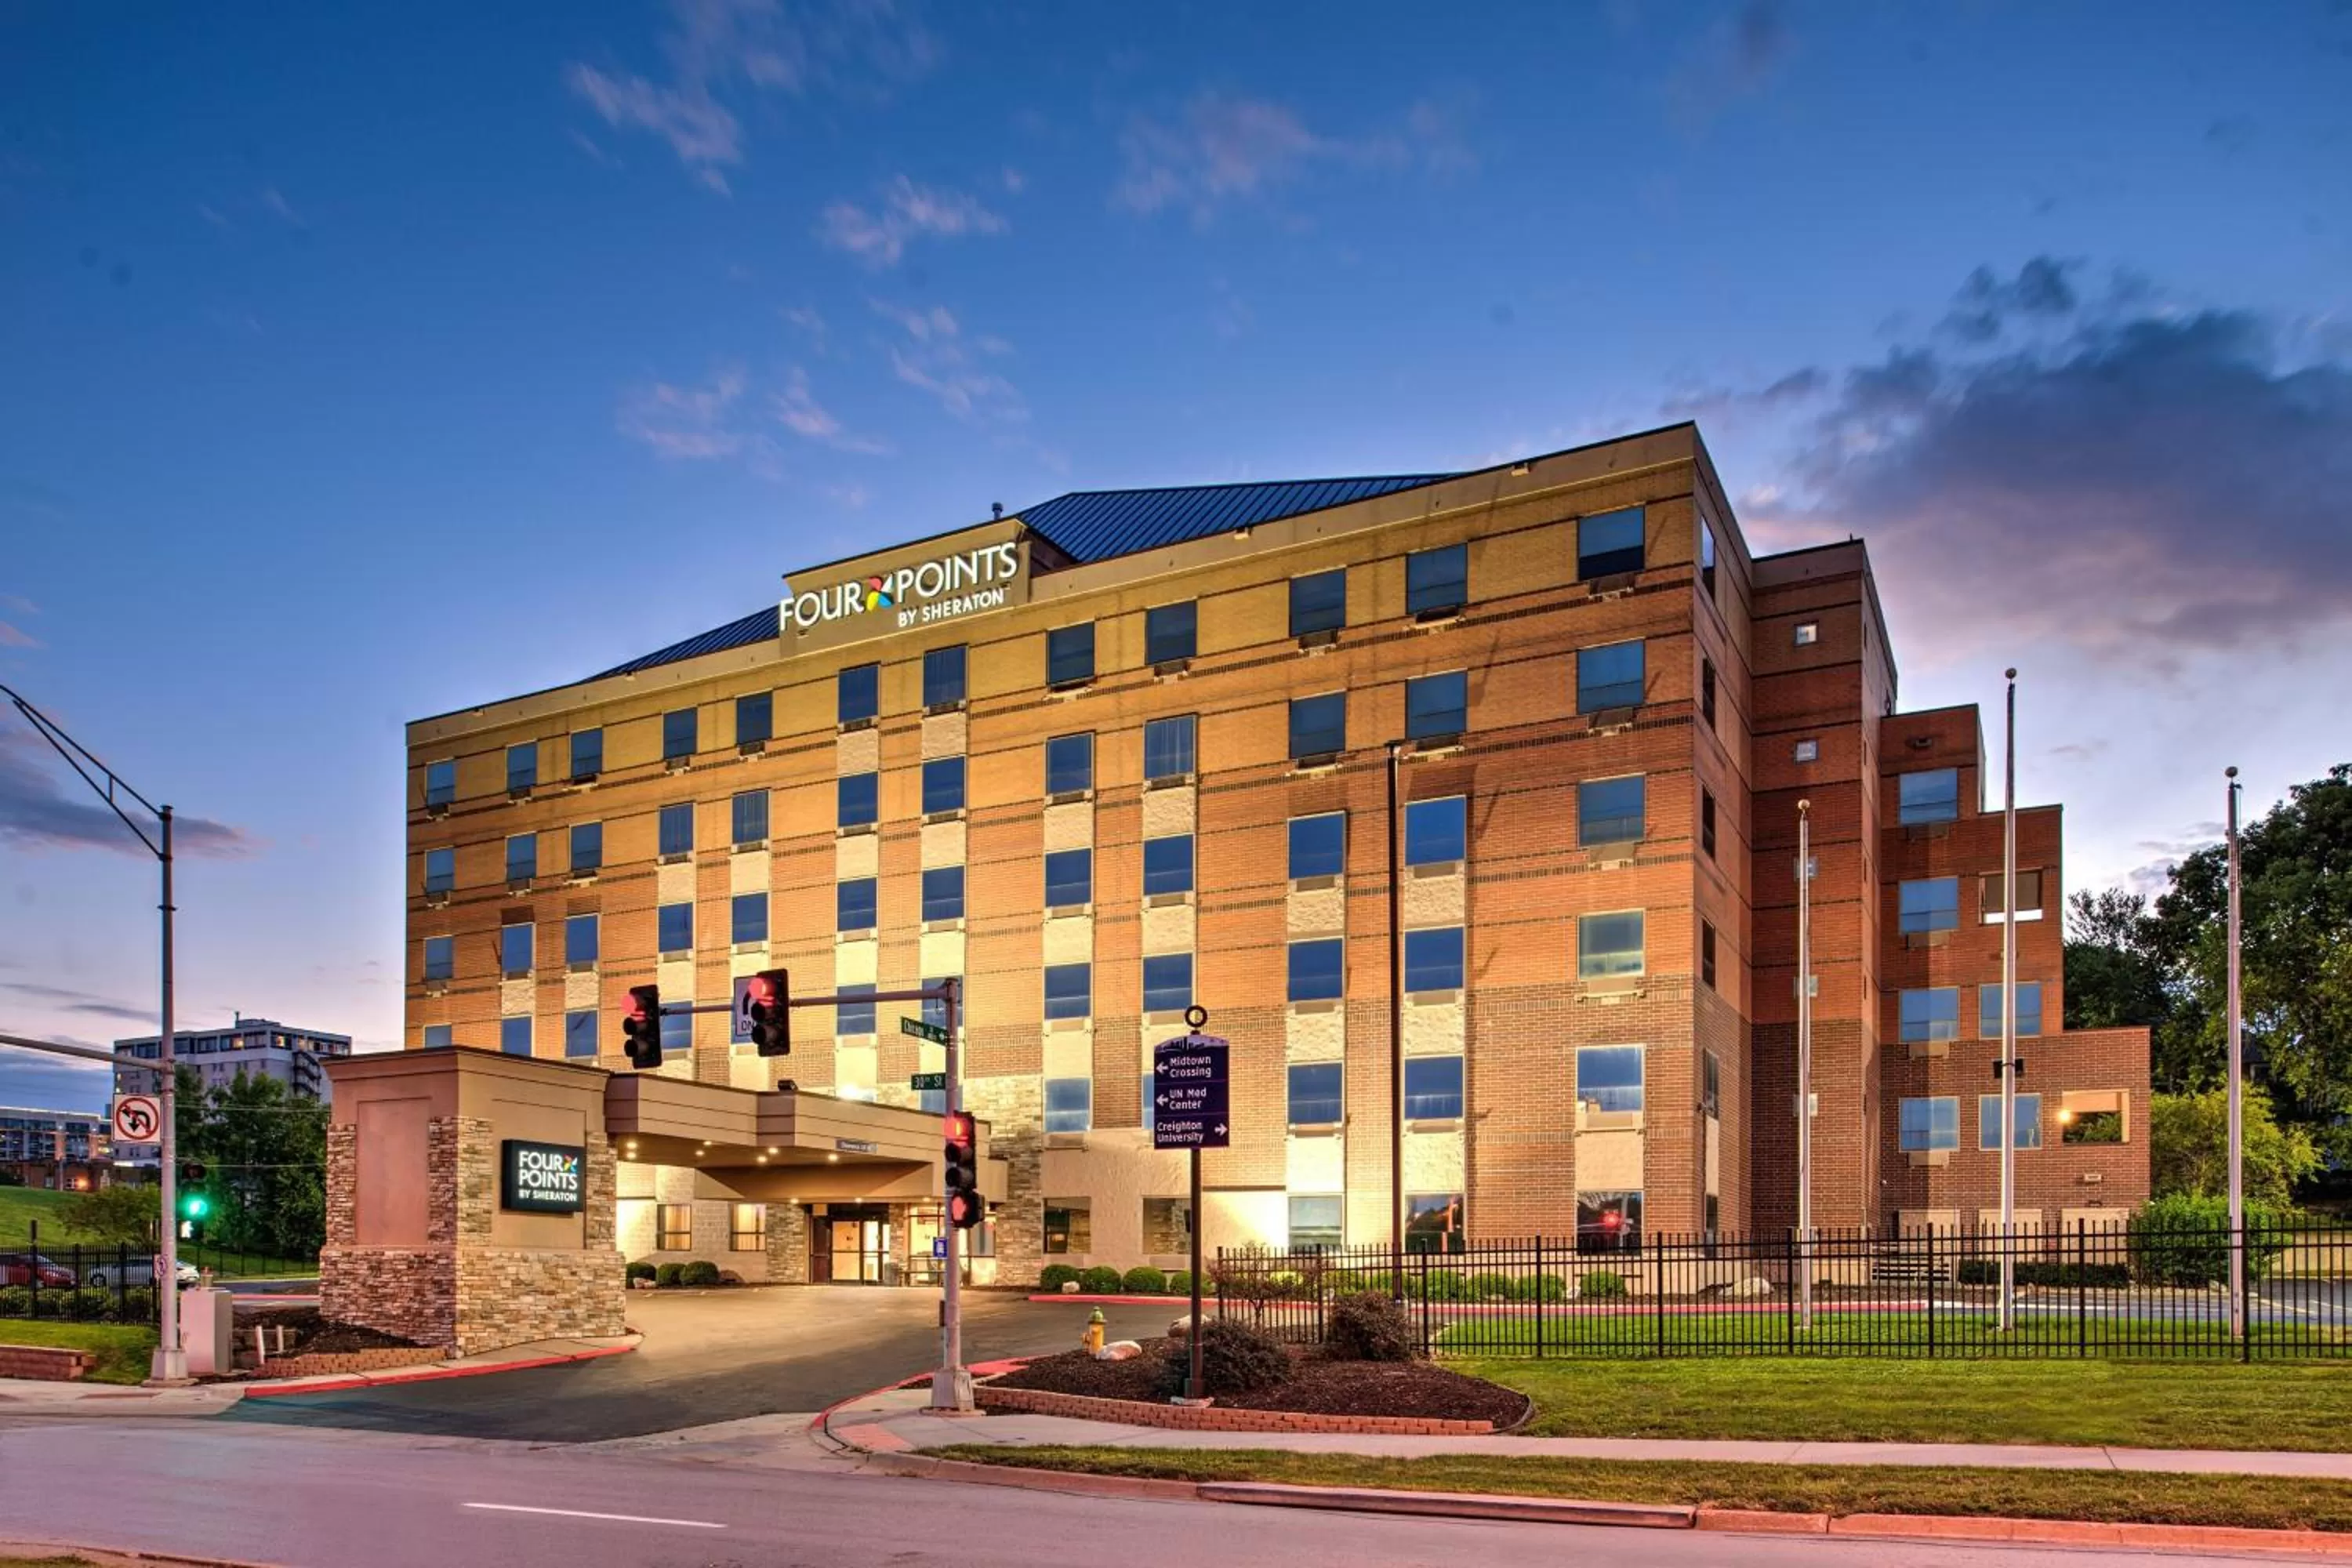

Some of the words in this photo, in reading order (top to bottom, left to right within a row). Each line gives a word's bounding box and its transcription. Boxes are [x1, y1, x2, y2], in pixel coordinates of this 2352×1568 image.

[779, 582, 866, 631] FOUR
[896, 542, 1018, 603] POINTS
[898, 608, 916, 627] BY
[922, 588, 1005, 622] SHERATON
[1170, 1056, 1211, 1065] Midtown
[1170, 1066, 1211, 1078] Crossing
[1169, 1088, 1183, 1098] UN
[1187, 1087, 1207, 1098] Med
[1170, 1100, 1202, 1110] Center
[1156, 1121, 1203, 1133] Creighton
[1157, 1133, 1204, 1144] University
[519, 1150, 563, 1171] FOUR
[519, 1169, 578, 1190] POINTS
[518, 1189, 531, 1199] BY
[532, 1190, 578, 1202] SHERATON
